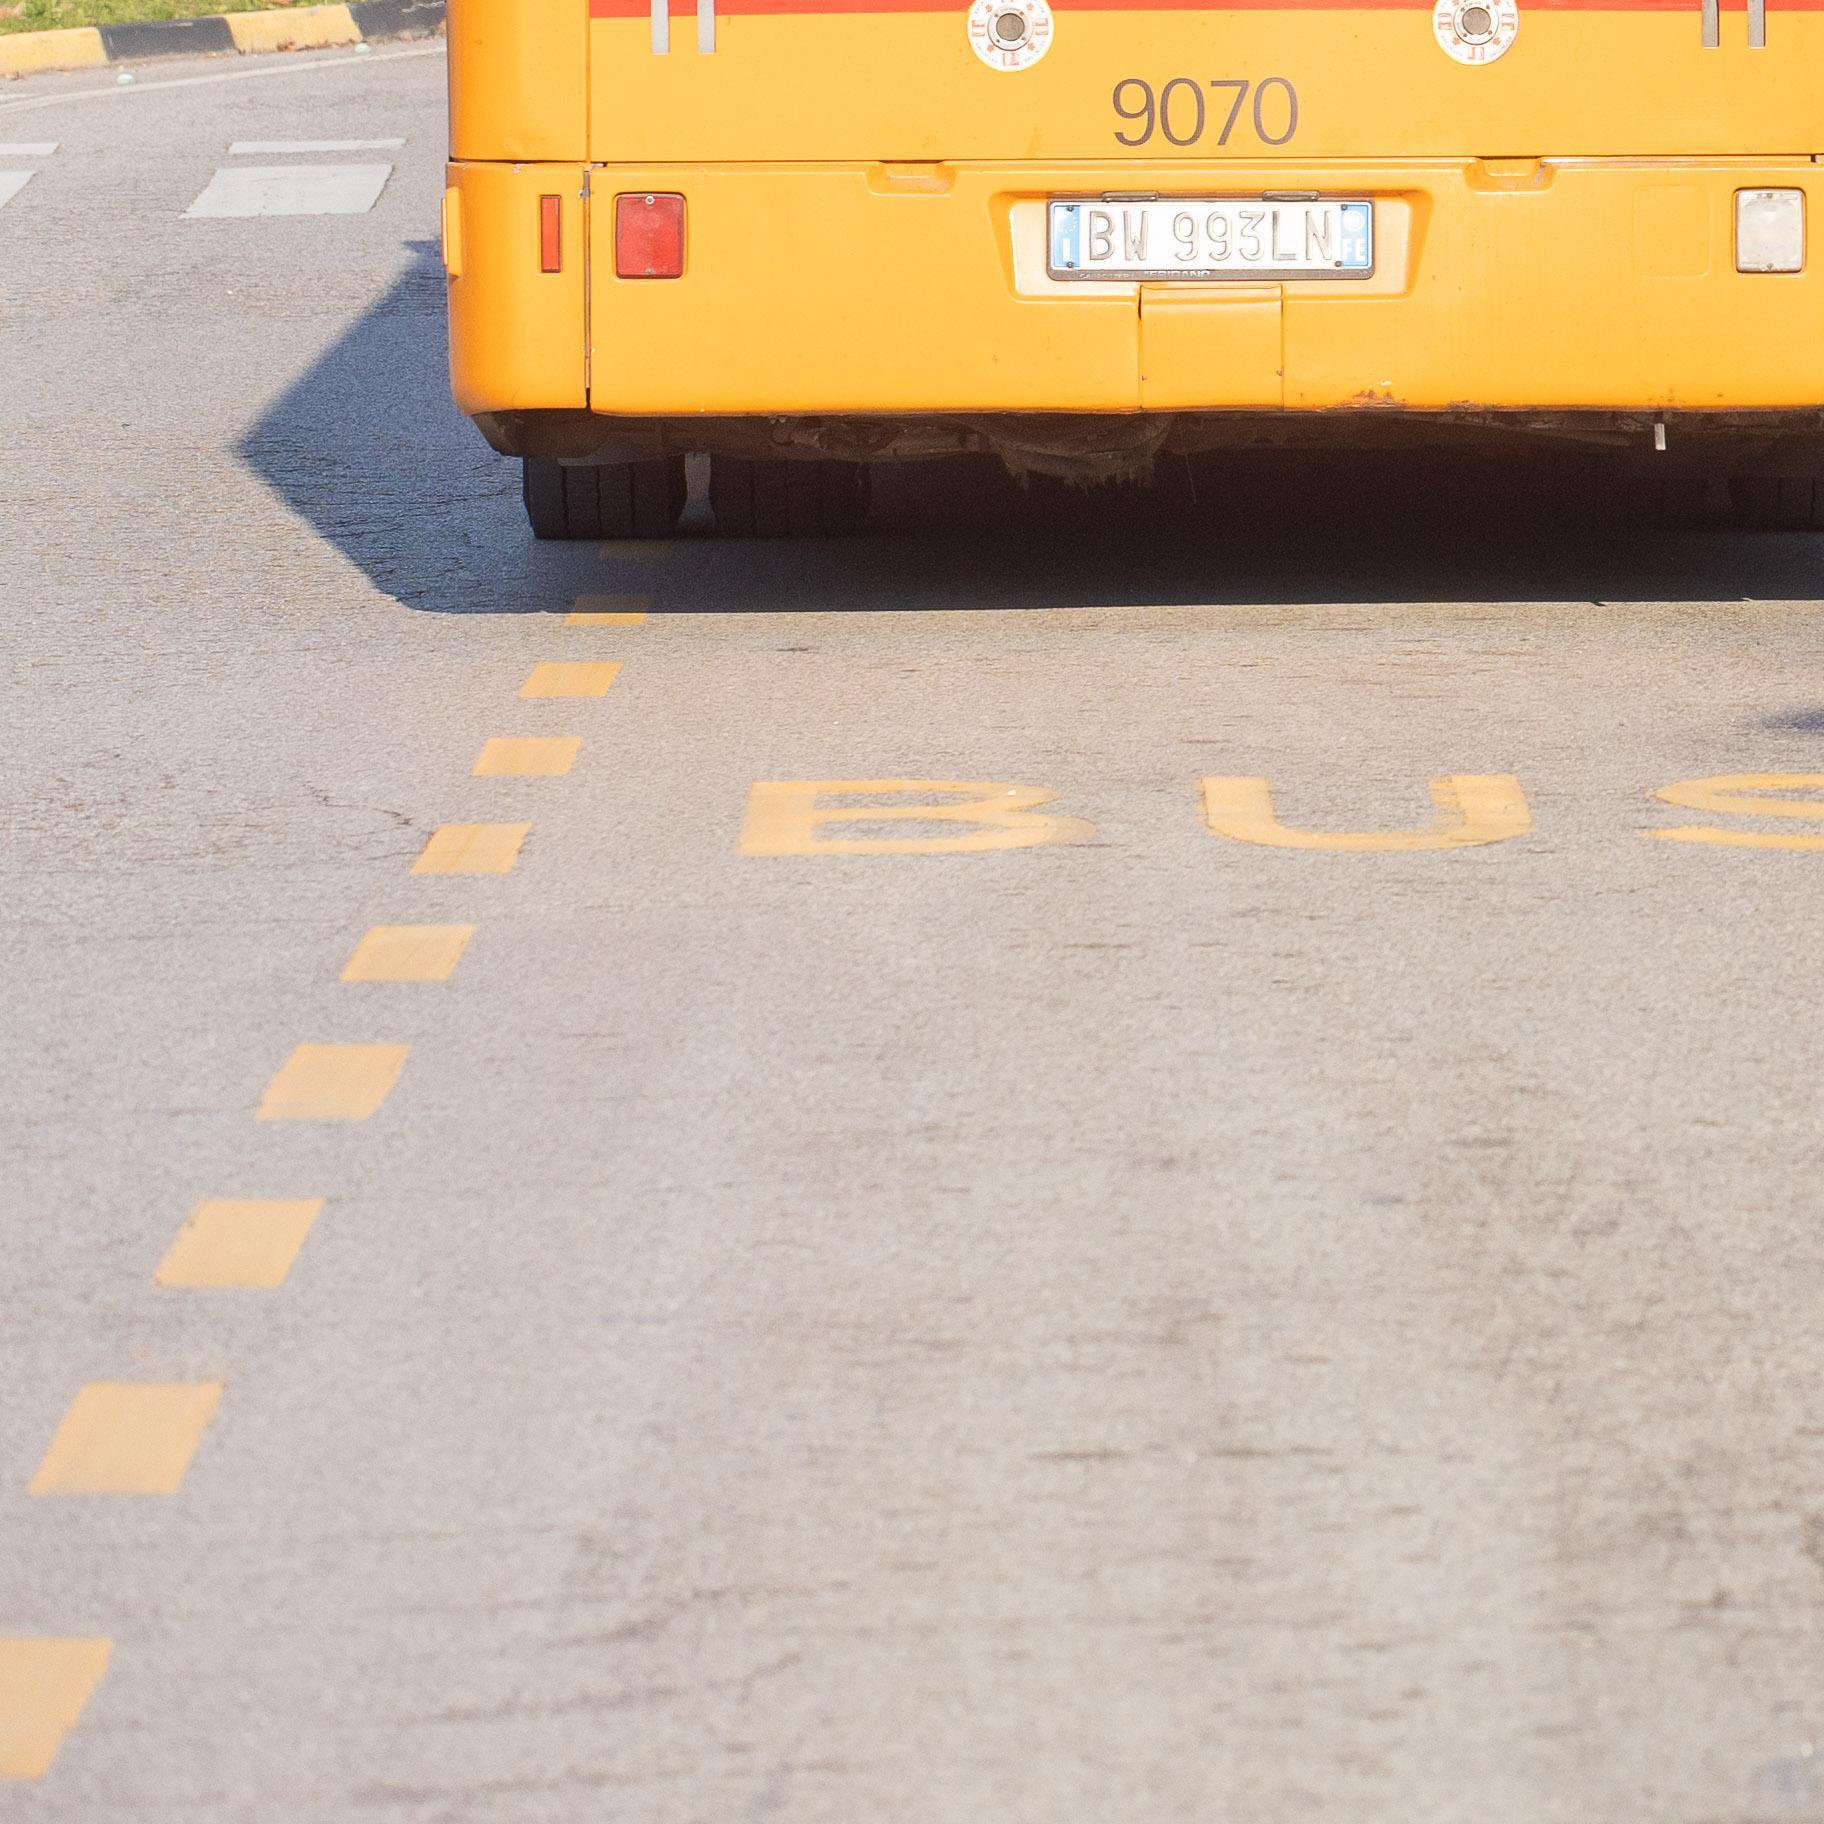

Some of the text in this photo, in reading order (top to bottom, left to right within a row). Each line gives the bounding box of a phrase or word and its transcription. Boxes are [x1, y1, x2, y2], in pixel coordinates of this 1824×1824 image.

[1112, 77, 1299, 146] 9070
[1089, 210, 1149, 262] BW
[1172, 210, 1333, 262] 993LN
[1342, 238, 1366, 262] FE
